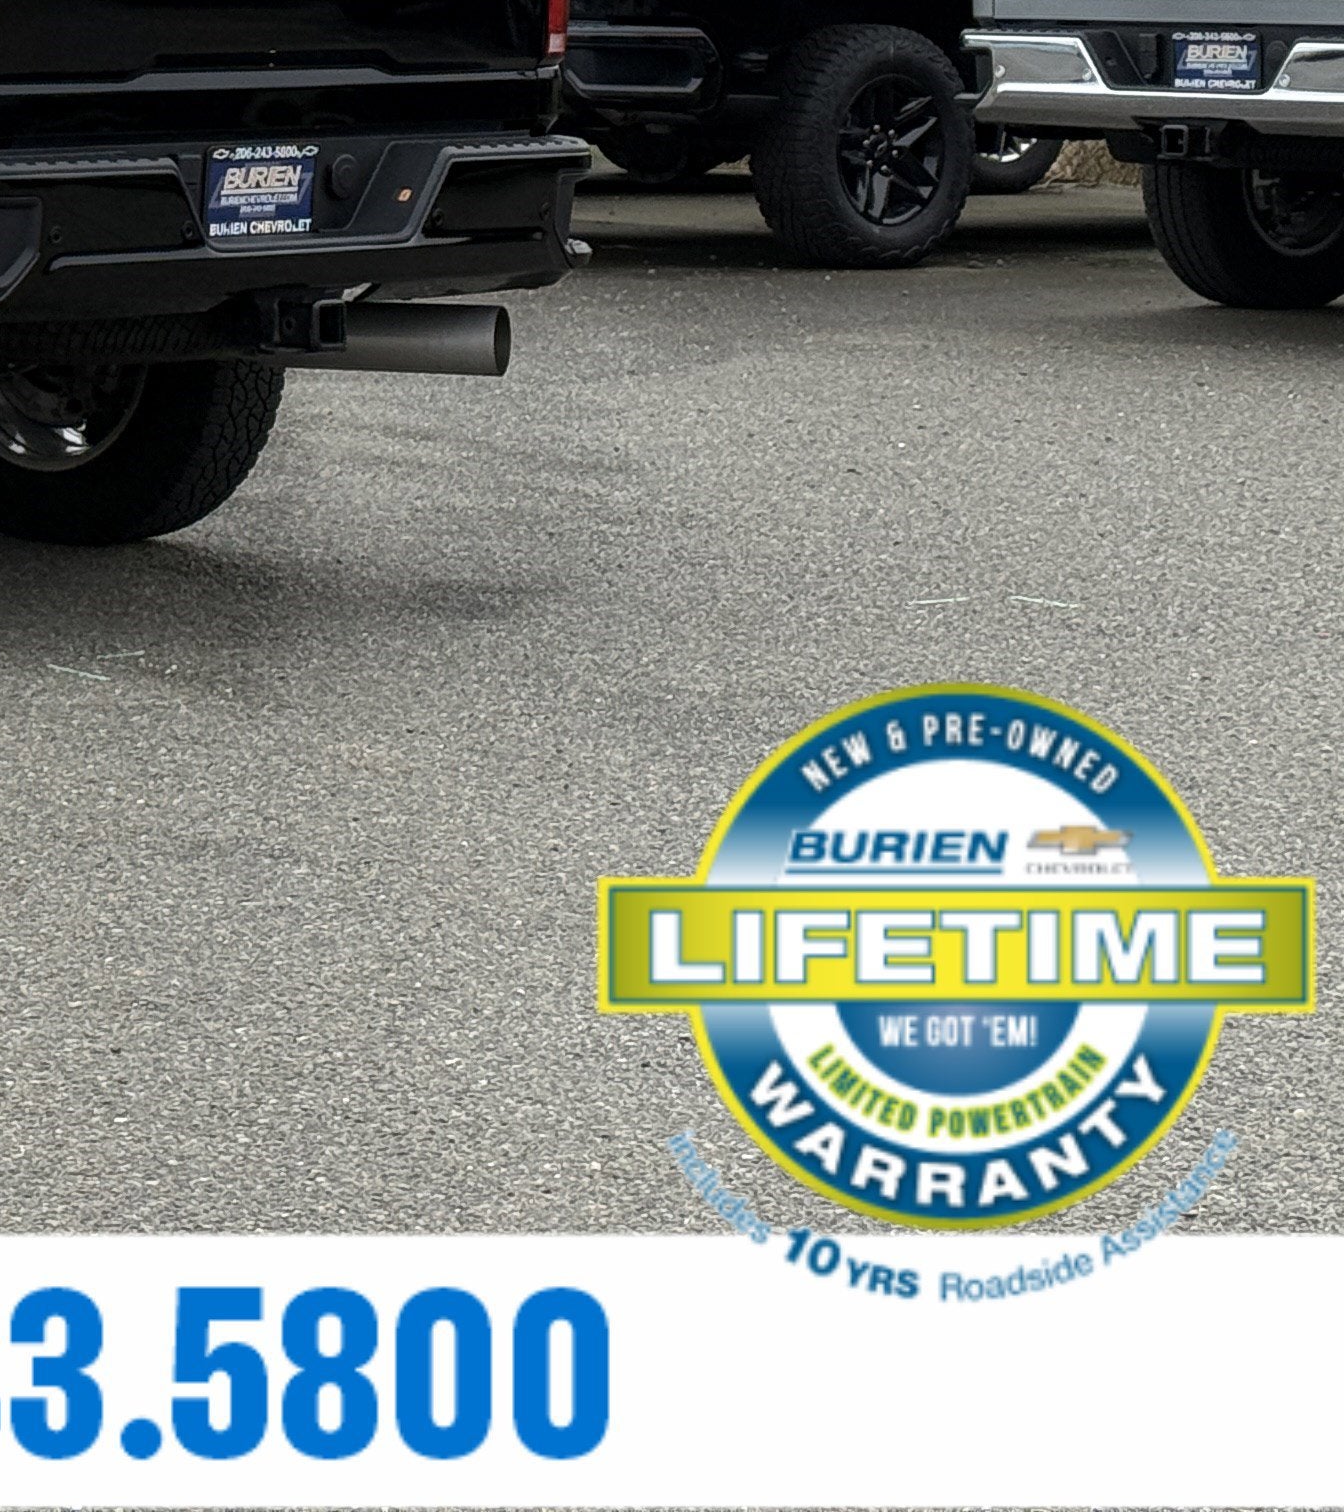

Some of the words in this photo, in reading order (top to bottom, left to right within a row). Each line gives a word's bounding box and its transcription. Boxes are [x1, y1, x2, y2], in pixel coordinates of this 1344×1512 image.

[1187, 44, 1248, 59] BURIEN
[223, 164, 303, 190] BURIEN
[249, 218, 312, 234] CHEVROLET
